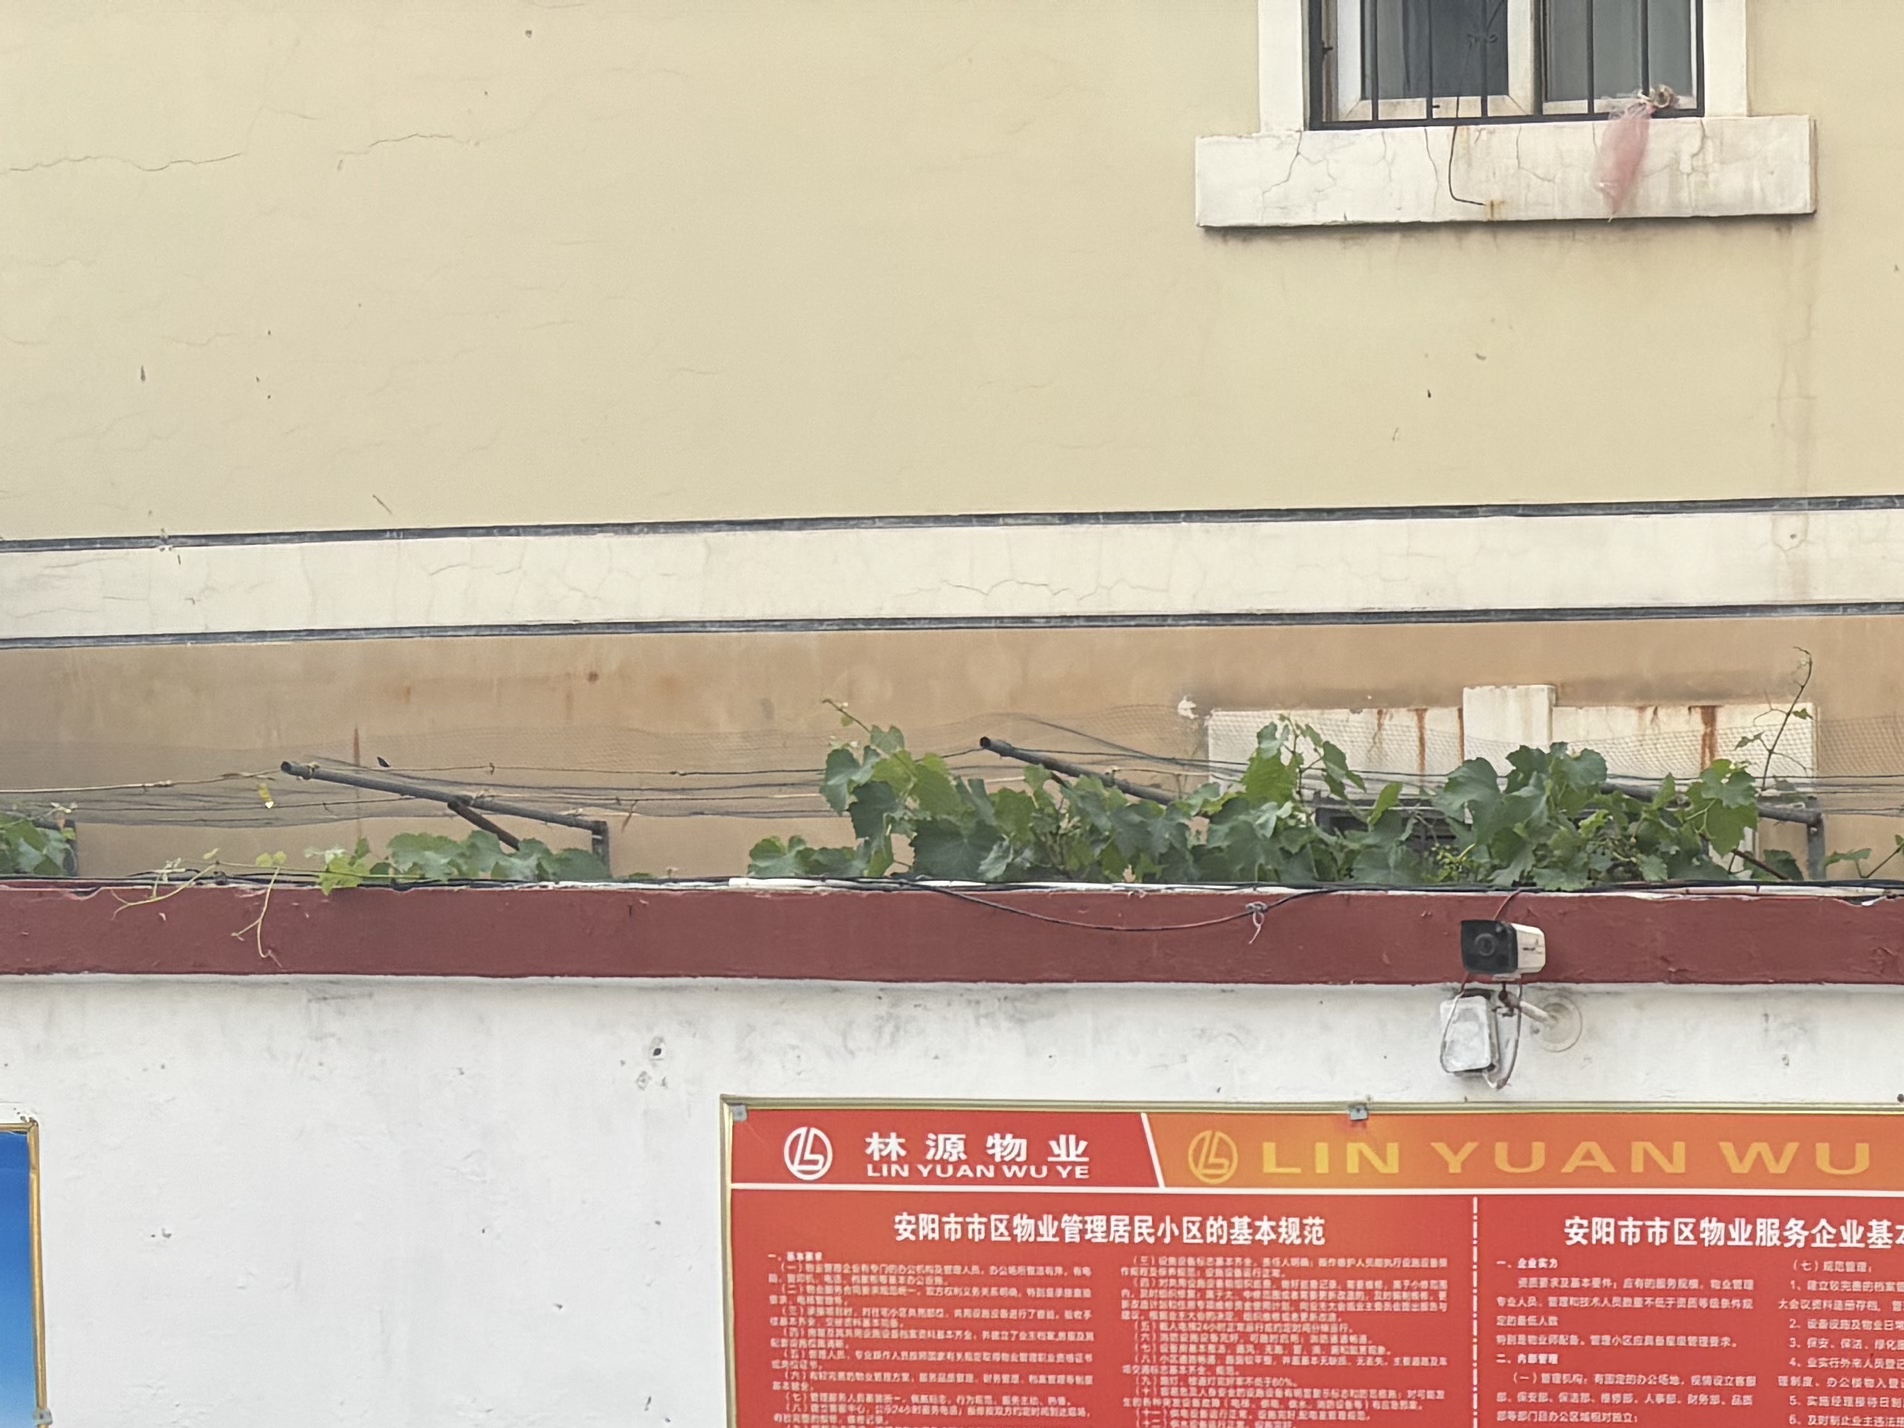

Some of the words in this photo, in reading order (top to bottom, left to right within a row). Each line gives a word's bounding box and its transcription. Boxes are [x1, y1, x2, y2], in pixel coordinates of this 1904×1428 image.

[865, 1132, 1090, 1163] 林源物业
[1262, 1141, 1400, 1175] LIN
[1431, 1141, 1695, 1176] YUAN
[1721, 1142, 1883, 1177] WU
[866, 1163, 911, 1178] LIN
[917, 1163, 998, 1179] YUAN
[1004, 1164, 1049, 1179] WU
[1053, 1165, 1090, 1180] YE
[893, 1213, 1327, 1246] 安阳市市区物业管理居民小区的基本规范
